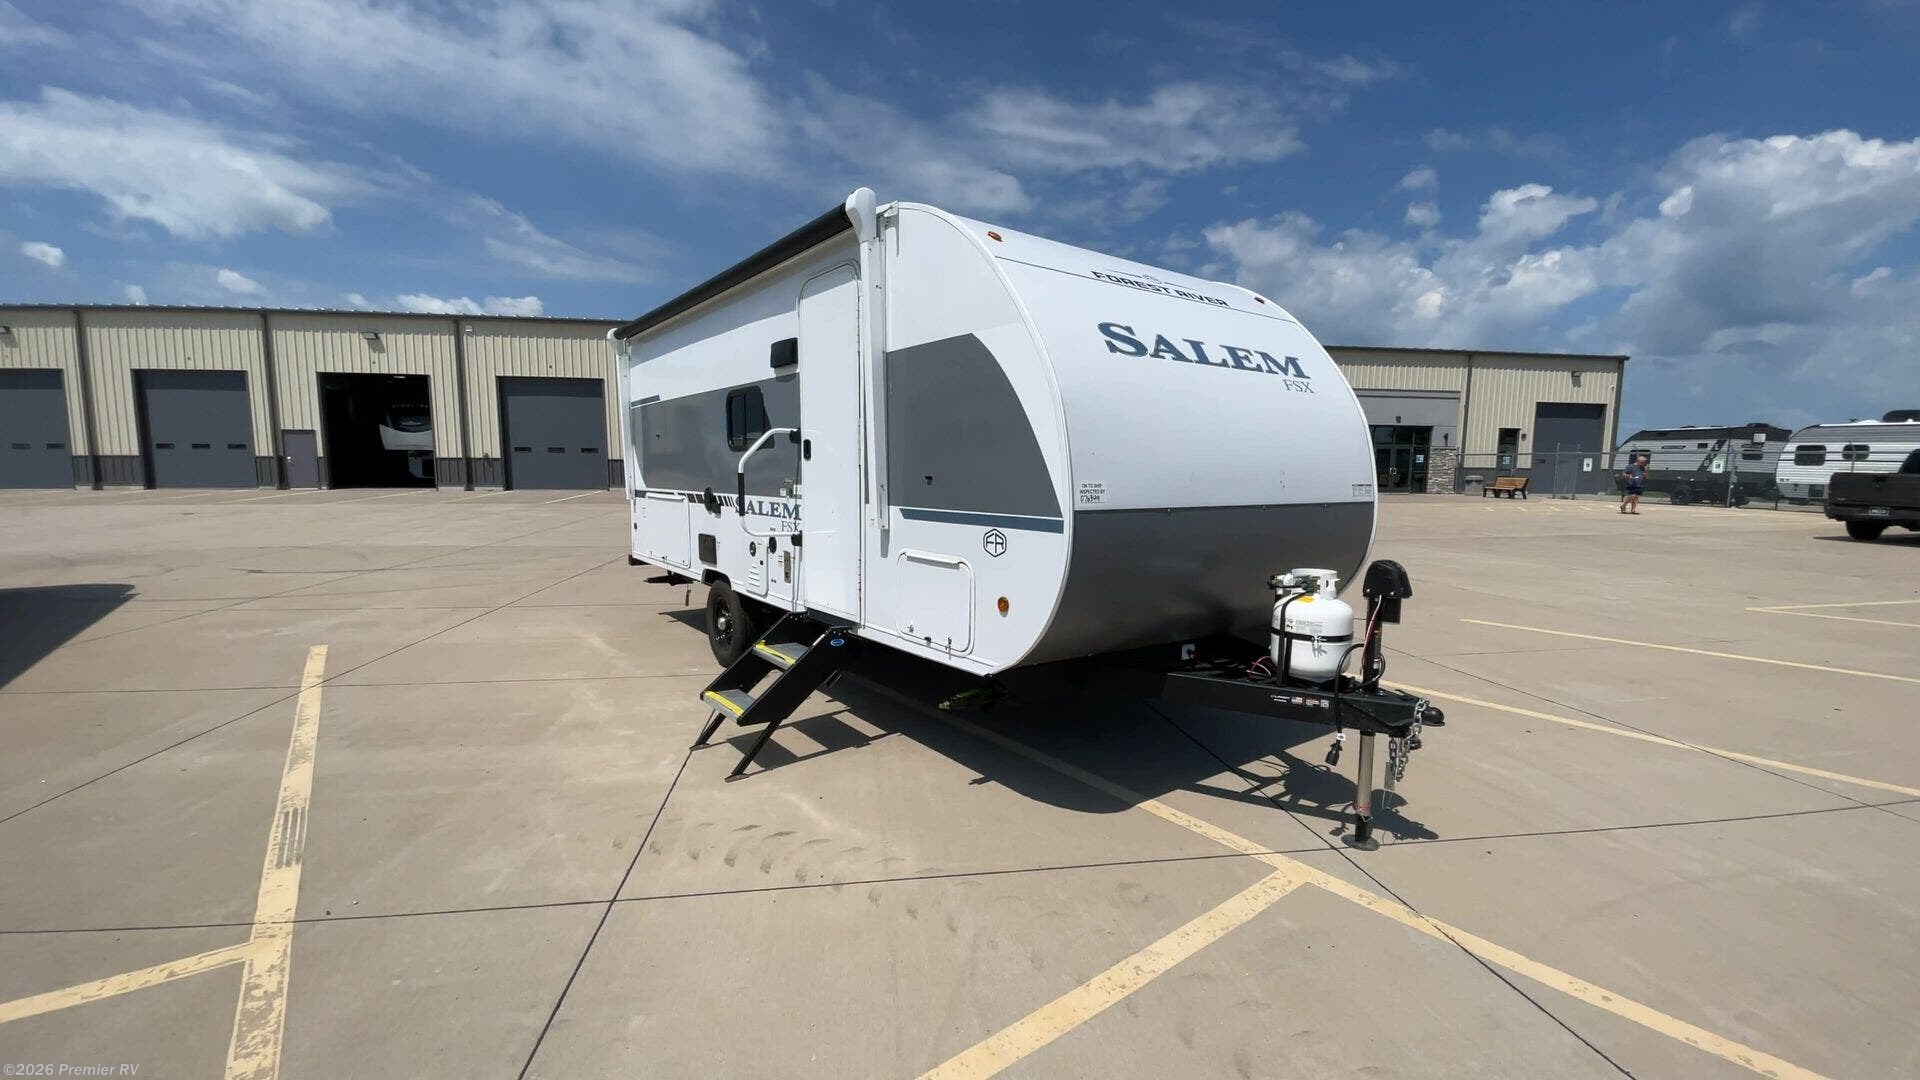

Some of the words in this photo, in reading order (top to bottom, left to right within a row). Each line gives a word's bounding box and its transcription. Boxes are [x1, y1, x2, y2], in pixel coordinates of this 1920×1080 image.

[1090, 270, 1170, 295] FOREST
[1174, 289, 1230, 307] RIVER
[1097, 321, 1312, 380] SALEM
[1282, 378, 1316, 394] FSX
[781, 520, 801, 532] FSX
